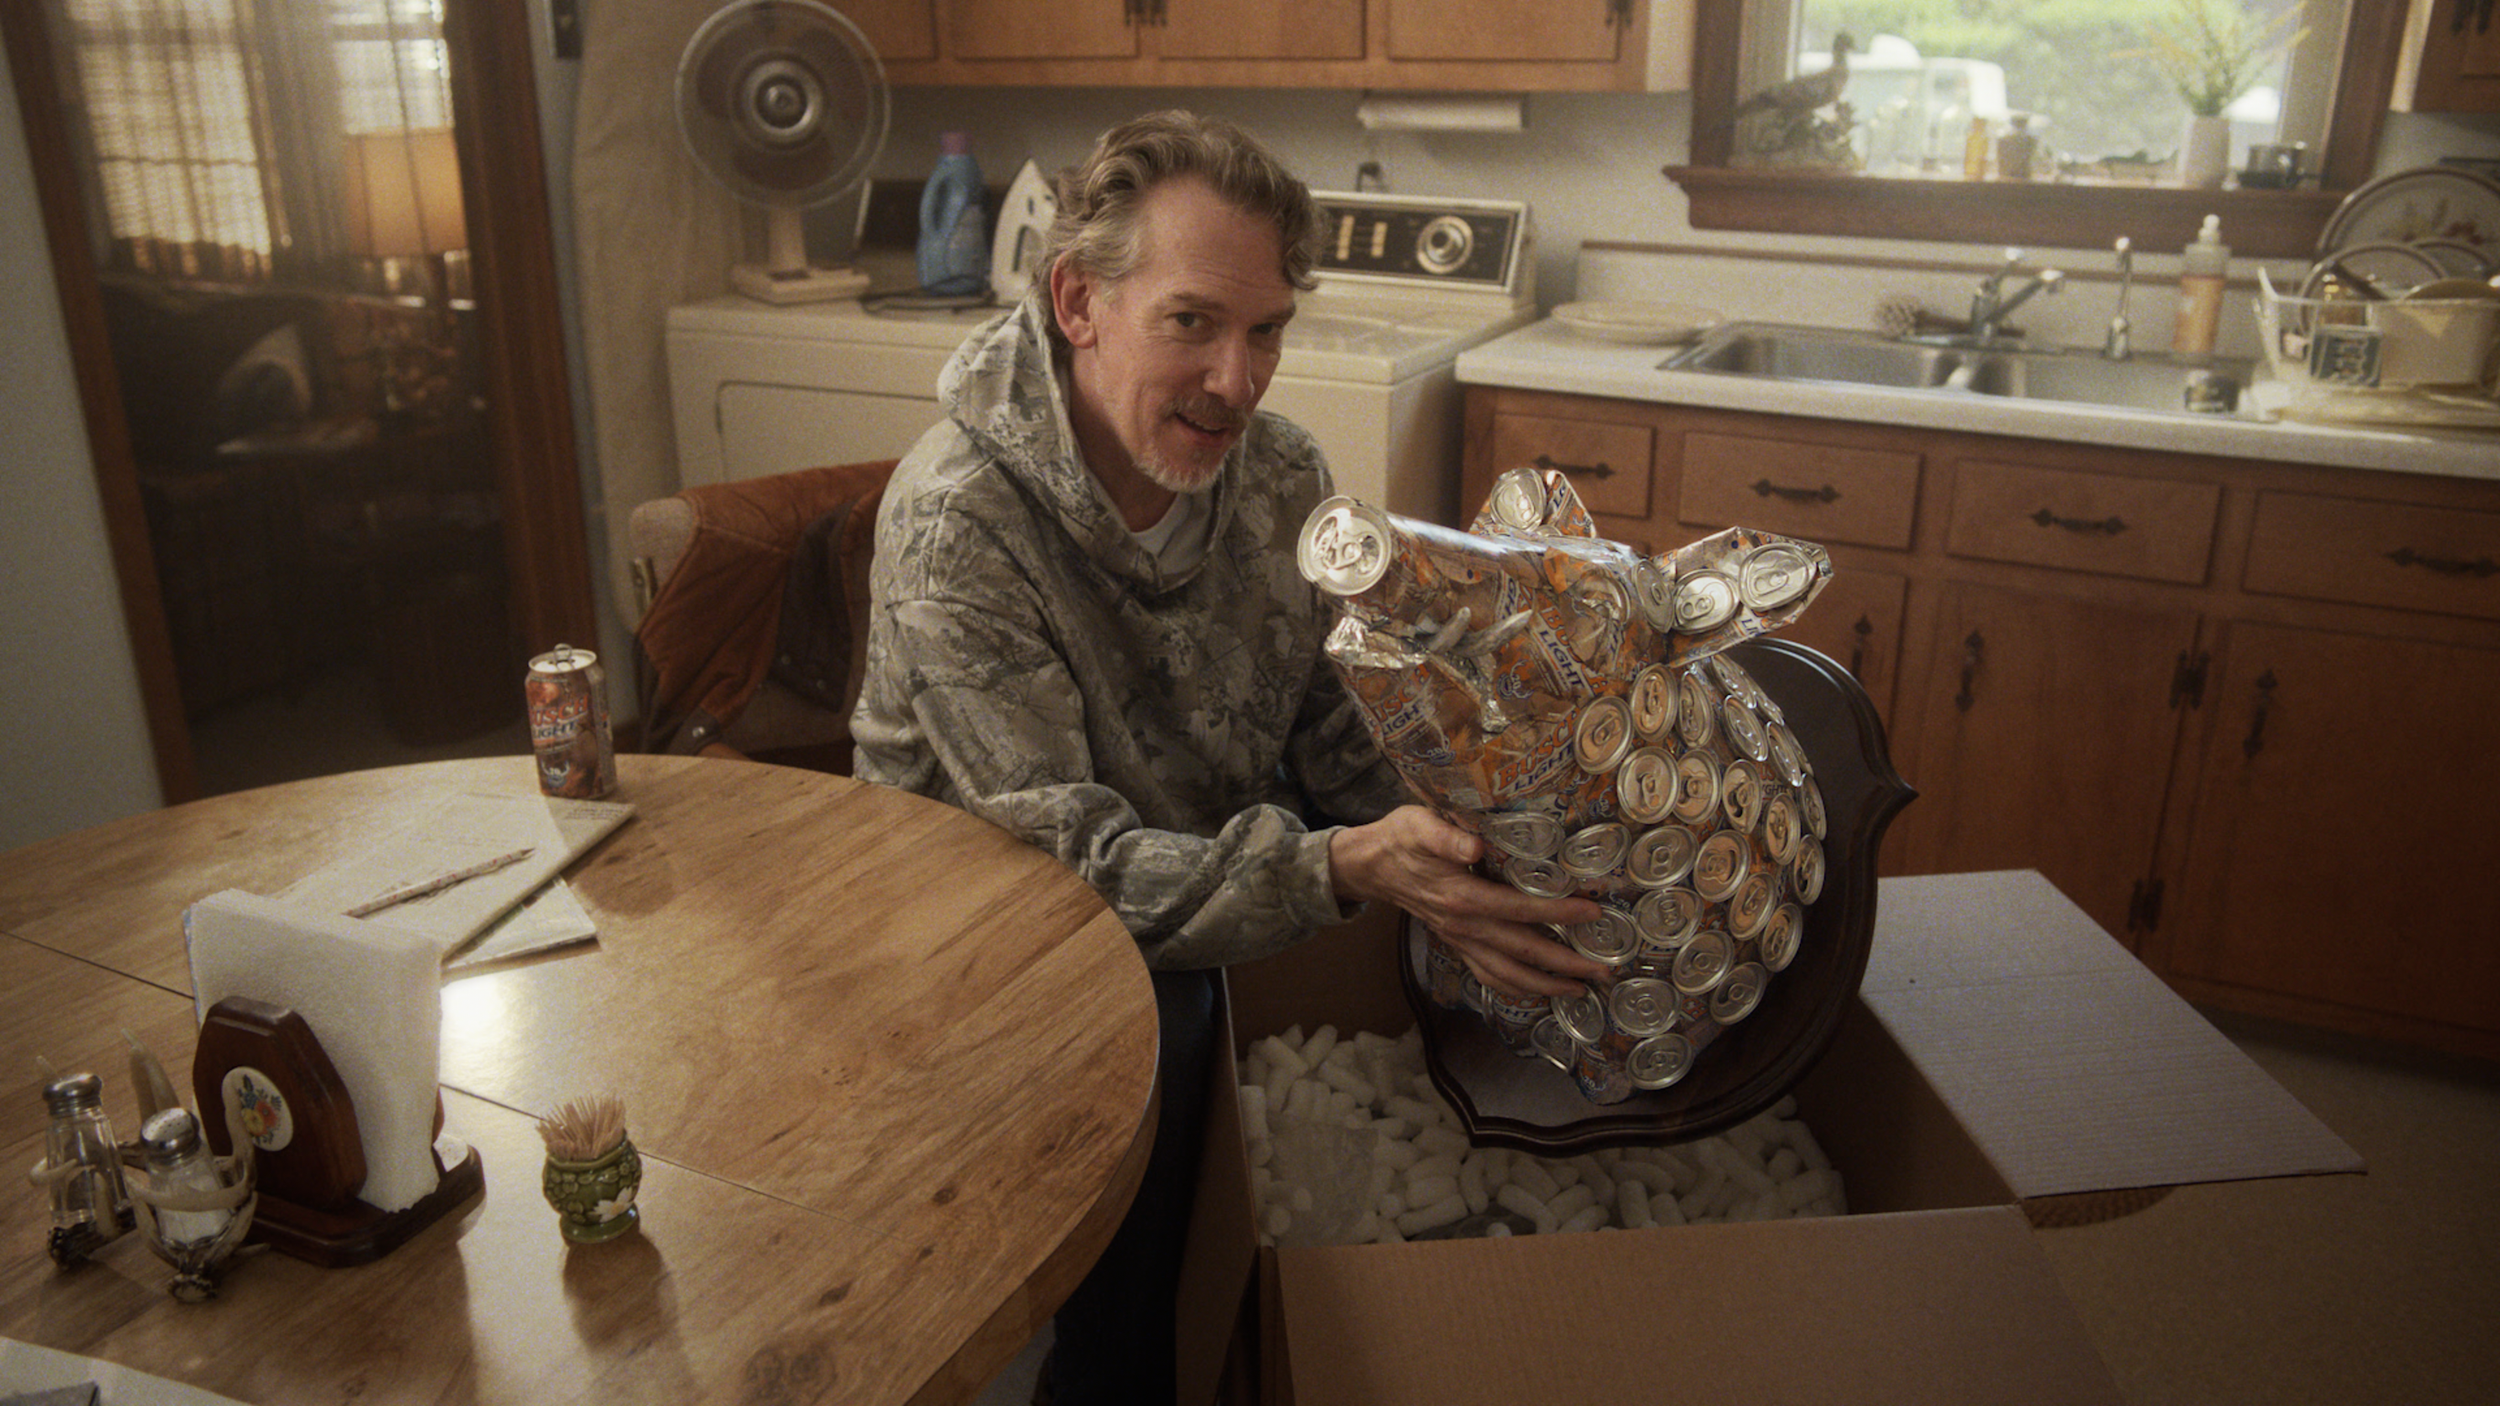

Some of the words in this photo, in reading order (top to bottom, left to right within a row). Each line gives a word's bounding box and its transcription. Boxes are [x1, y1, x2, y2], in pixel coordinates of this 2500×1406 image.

[1540, 629, 1585, 689] LIGHT
[530, 693, 589, 727] USCH
[1371, 663, 1430, 722] USCH
